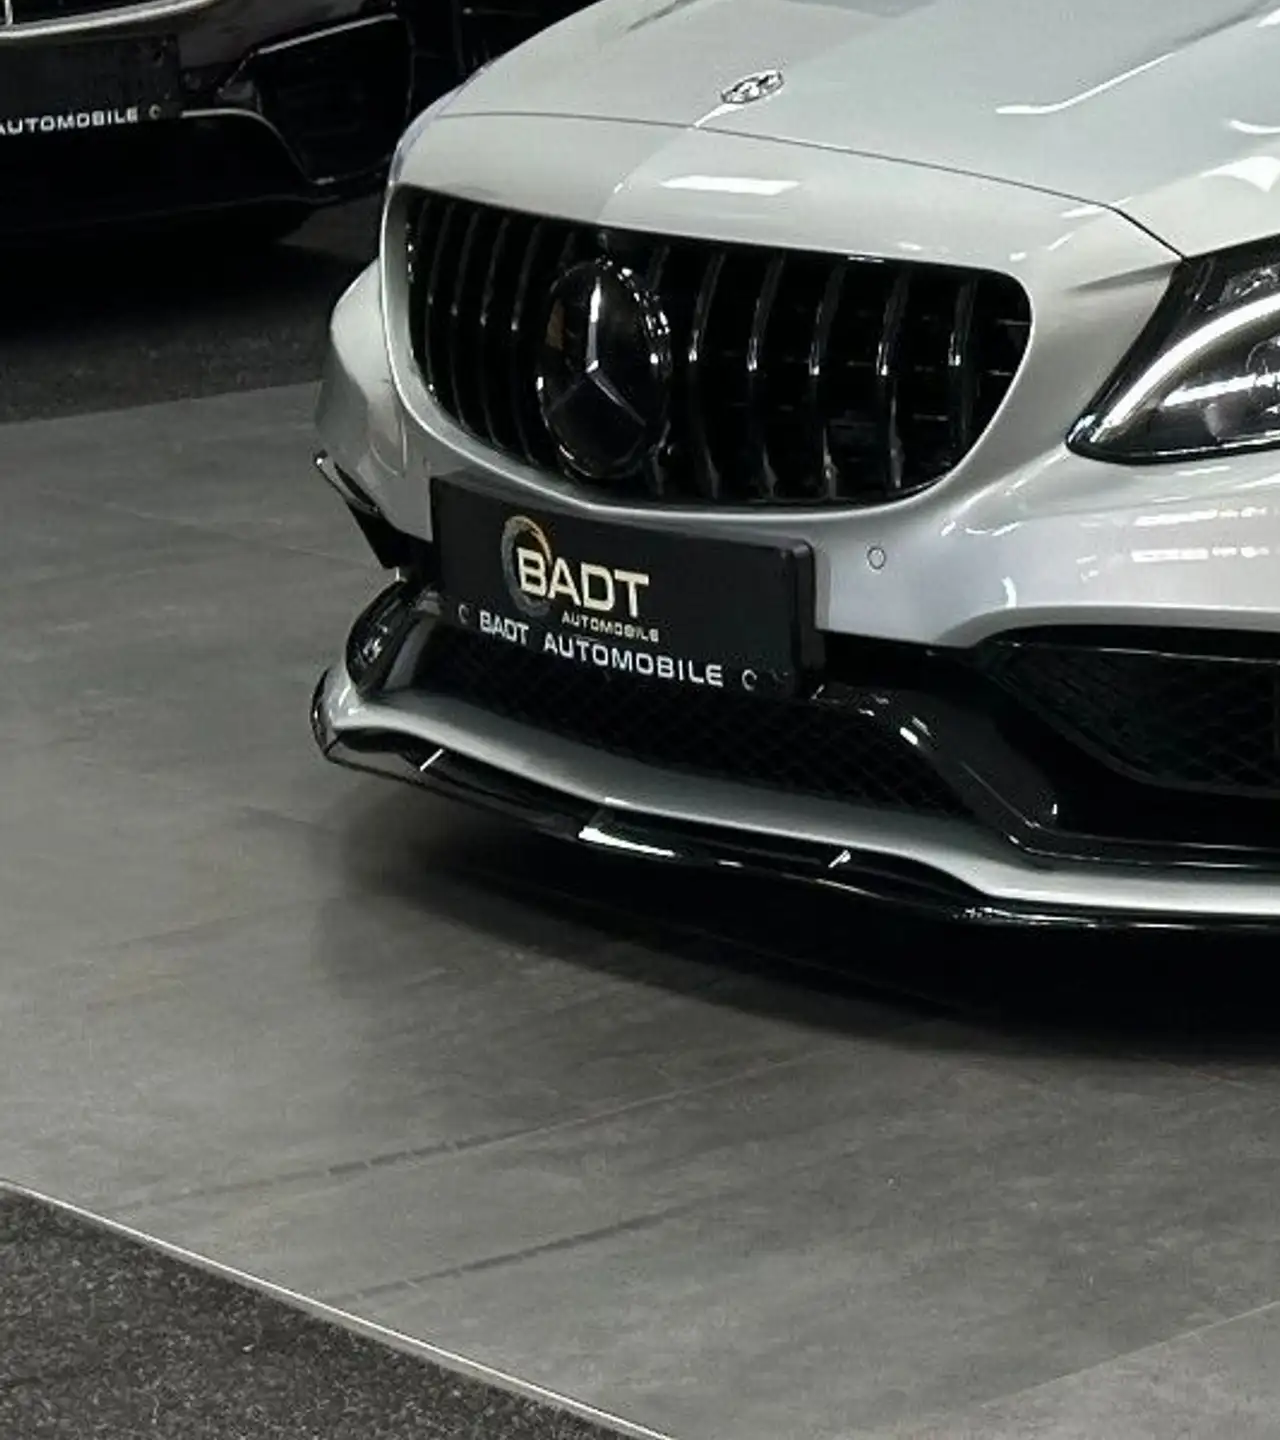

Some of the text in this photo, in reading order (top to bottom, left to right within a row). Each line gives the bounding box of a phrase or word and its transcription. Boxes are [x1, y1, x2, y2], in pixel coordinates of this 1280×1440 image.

[517, 547, 650, 617] BADT
[480, 609, 724, 688] BADT AUTOMOBILE
[561, 610, 659, 643] AUTOMOBILE
